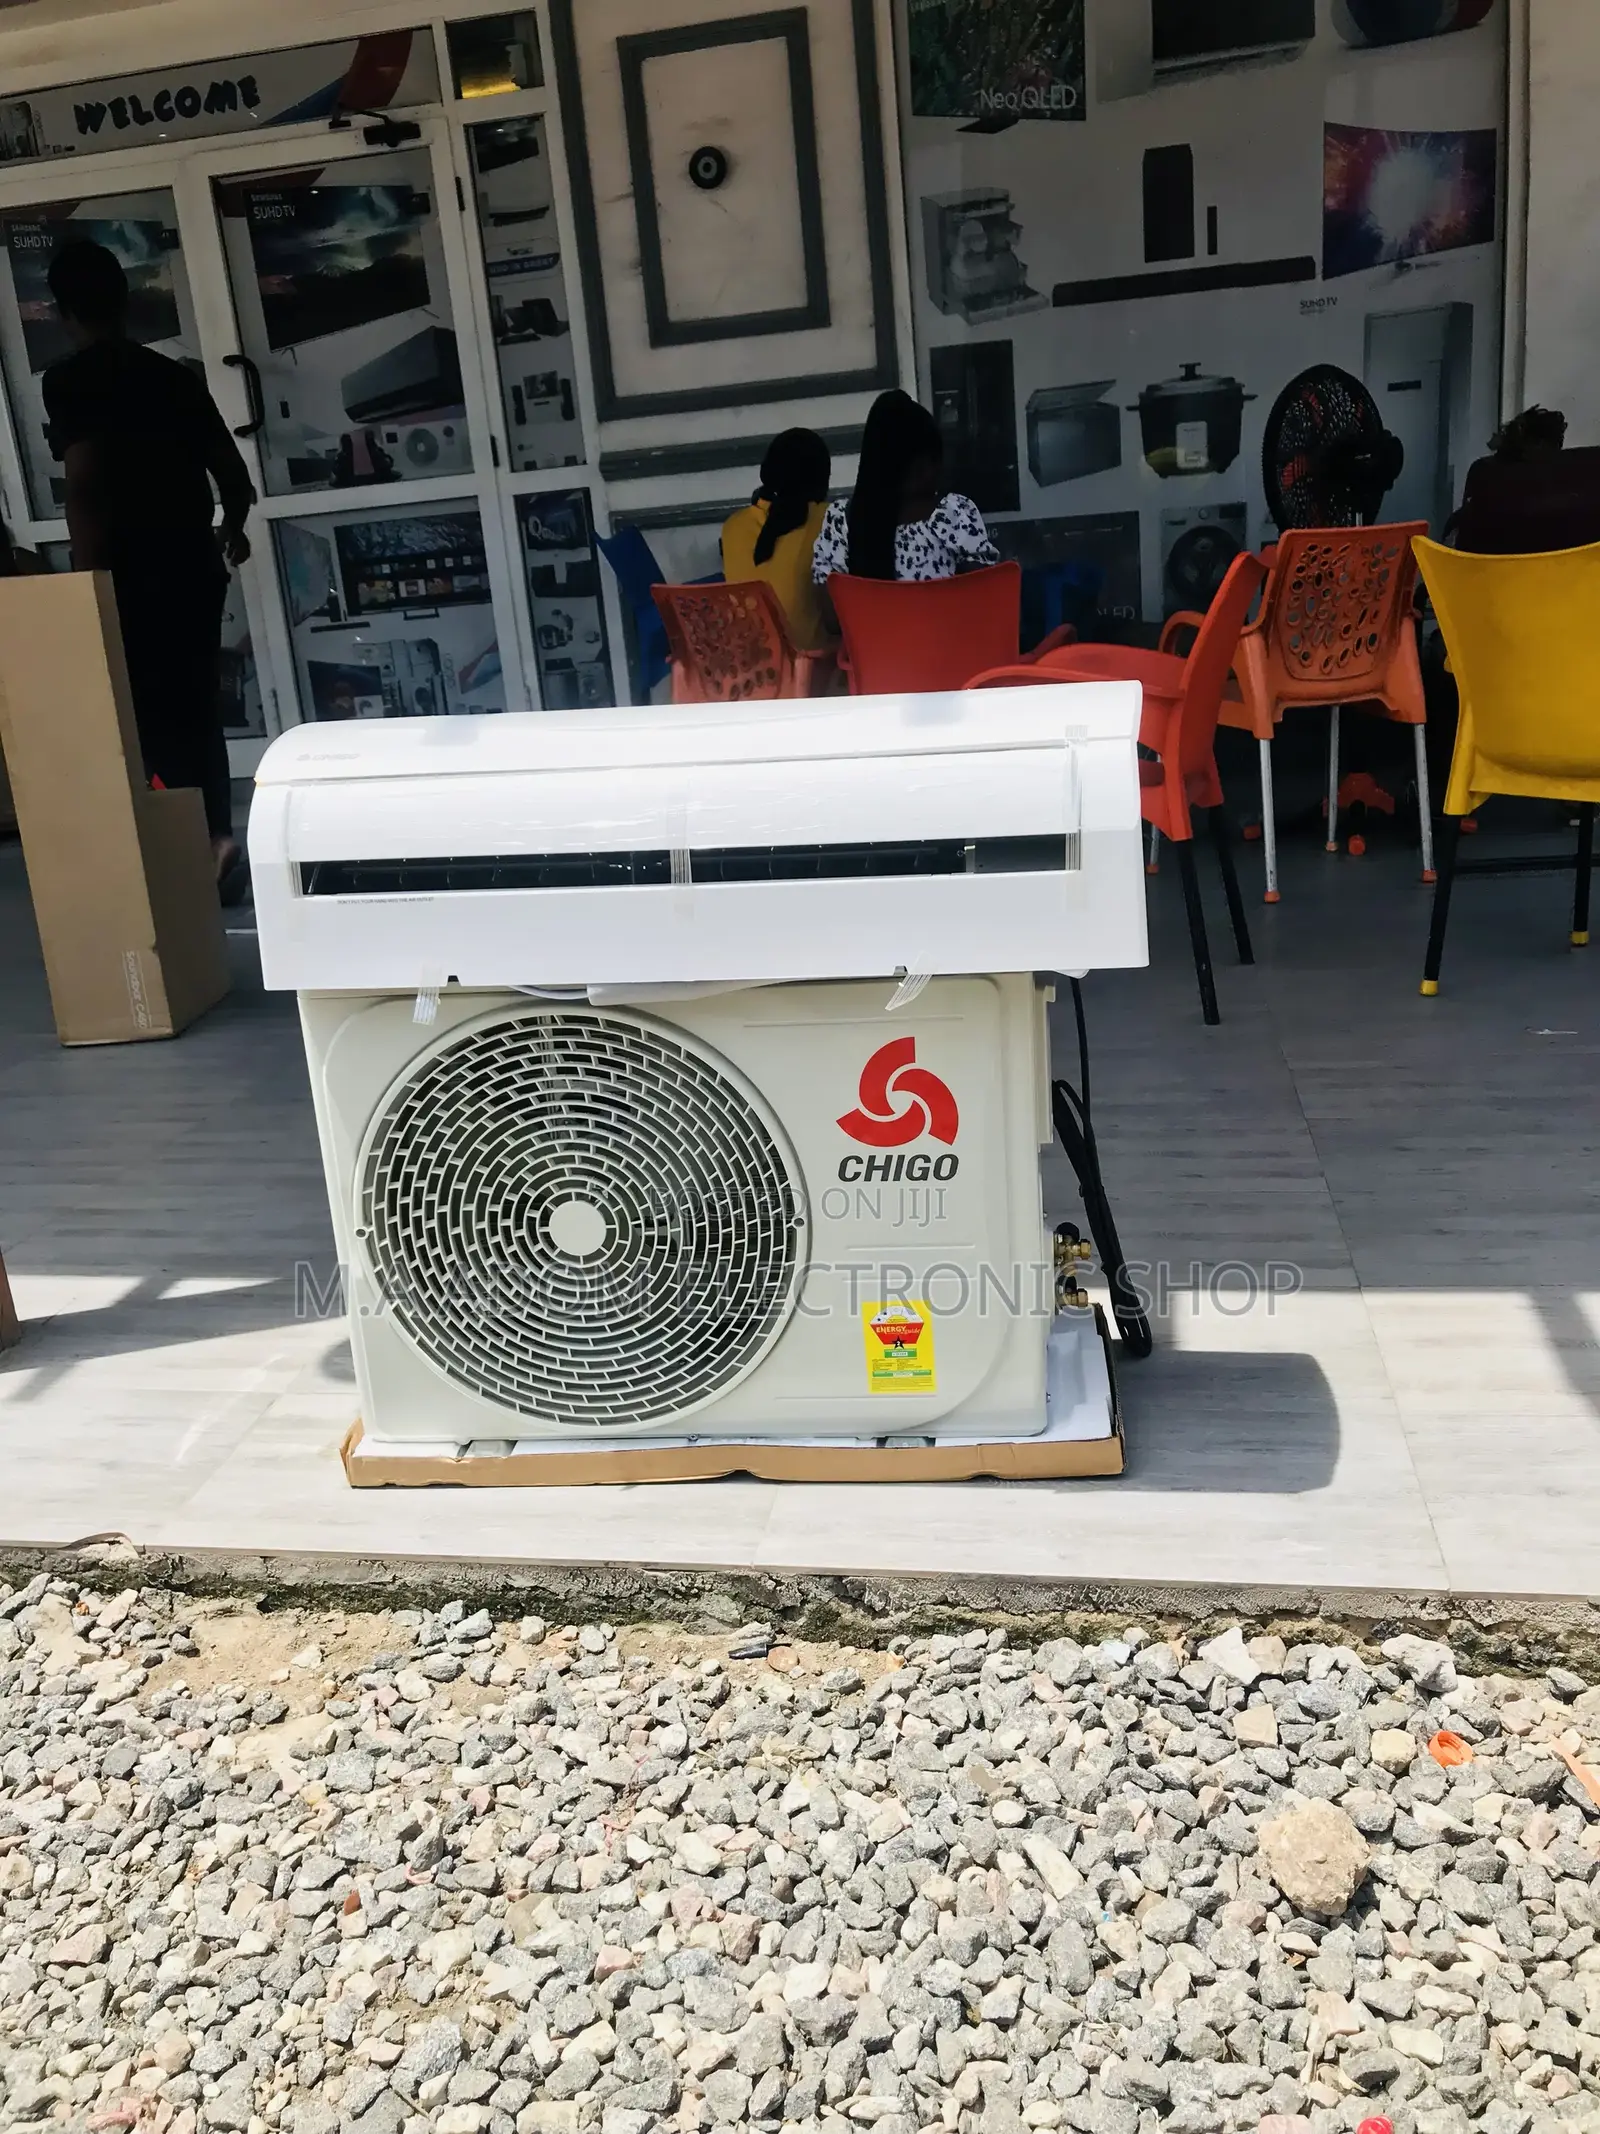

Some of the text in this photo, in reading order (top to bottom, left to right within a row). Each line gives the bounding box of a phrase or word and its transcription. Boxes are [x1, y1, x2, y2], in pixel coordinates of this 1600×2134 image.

[73, 75, 261, 135] WELCOME
[980, 84, 1077, 110] Neo QLED
[837, 1153, 960, 1183] CHIGO
[876, 1325, 907, 1335] ENERGY
